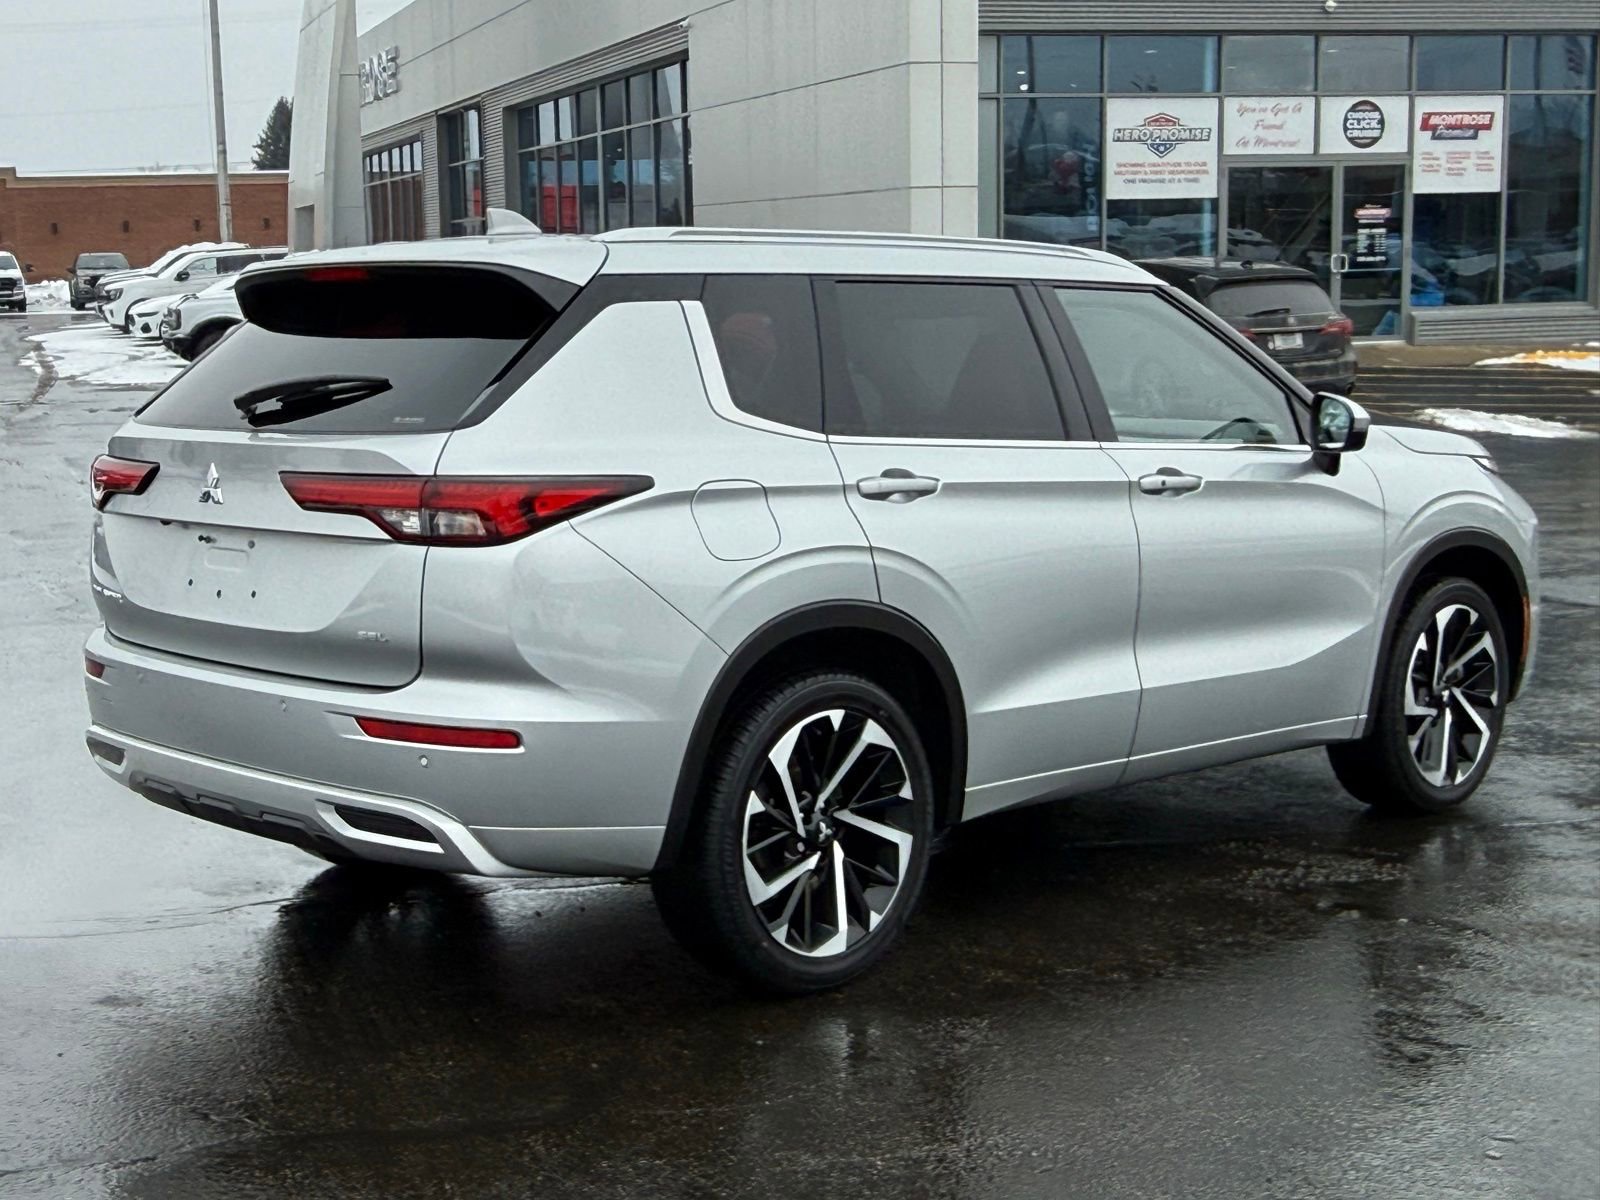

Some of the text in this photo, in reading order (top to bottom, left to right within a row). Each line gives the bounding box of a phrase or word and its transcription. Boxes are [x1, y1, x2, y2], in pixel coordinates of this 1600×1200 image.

[1428, 114, 1491, 125] MONTROSE
[1113, 128, 1211, 141] HERO PROMISE
